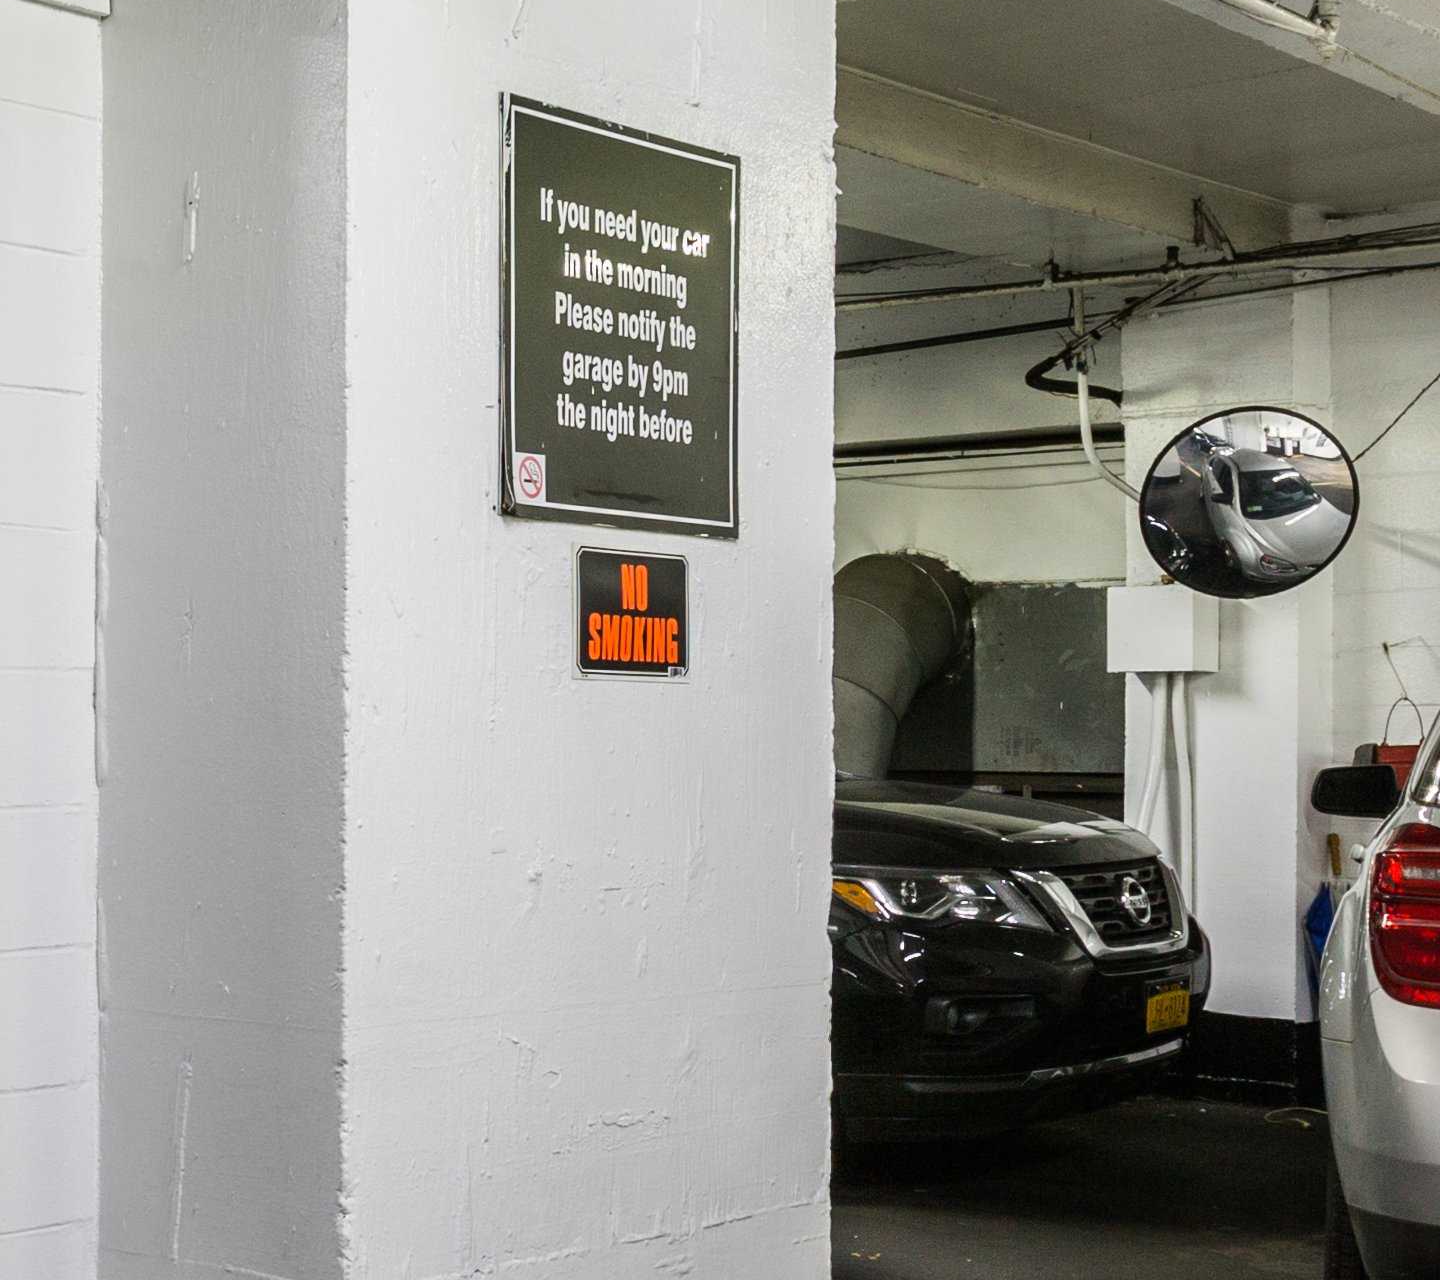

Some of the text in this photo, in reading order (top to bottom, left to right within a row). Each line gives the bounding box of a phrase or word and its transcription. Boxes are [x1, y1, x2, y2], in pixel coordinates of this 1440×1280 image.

[540, 188, 710, 258] If you need your car
[564, 243, 687, 309] in the morning
[555, 291, 696, 352] Please notify the
[563, 351, 688, 401] garage by 9pm
[557, 393, 693, 445] the night before
[621, 563, 648, 611] NO
[588, 612, 678, 664] SMOKING
